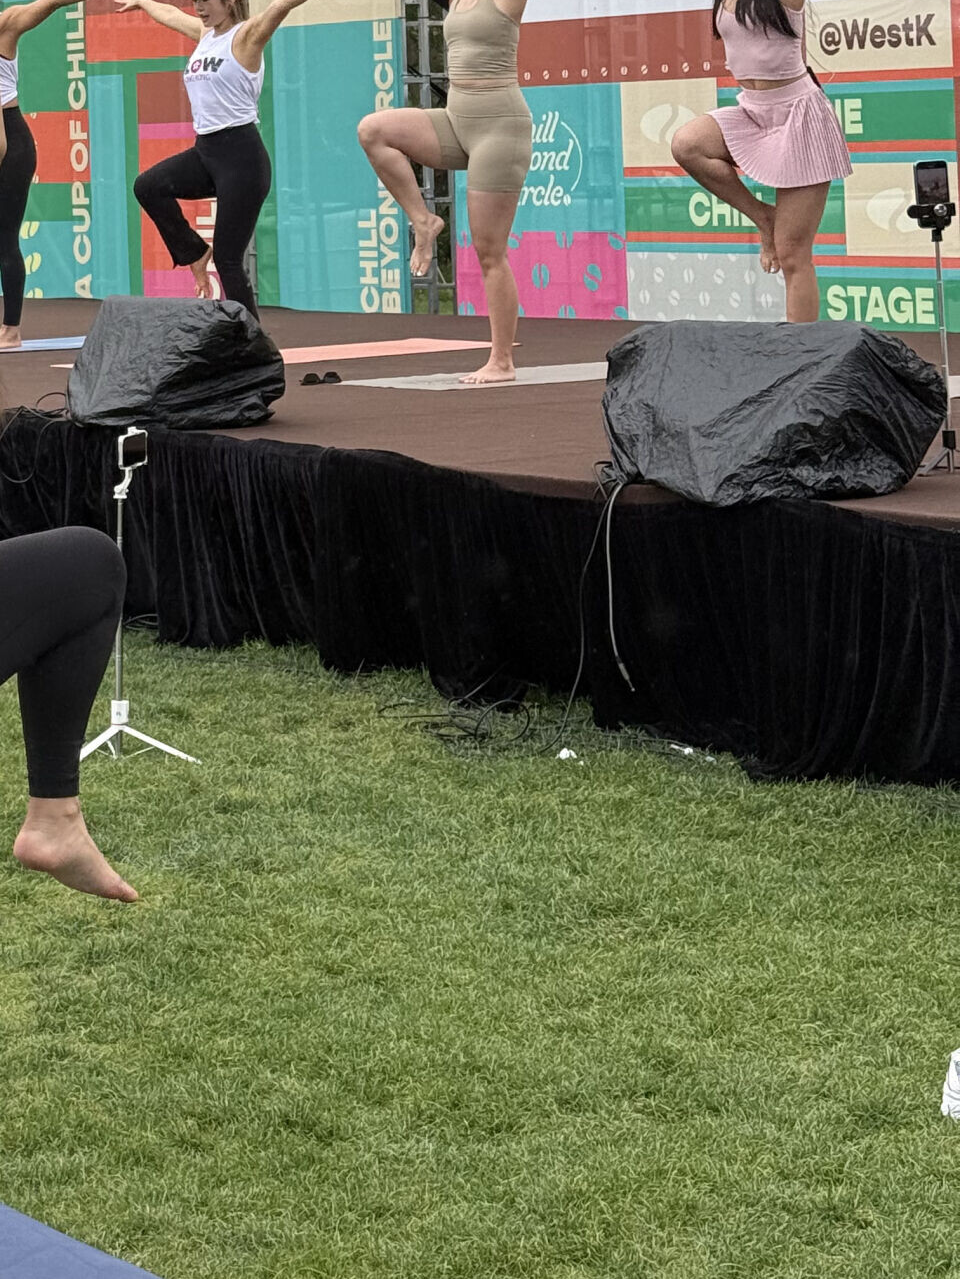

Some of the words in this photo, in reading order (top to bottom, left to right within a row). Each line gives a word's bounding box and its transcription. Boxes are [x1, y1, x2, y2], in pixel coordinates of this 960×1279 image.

[65, 0, 87, 112] CHILL
[818, 13, 937, 56] @WestK
[69, 119, 89, 173] OF
[71, 180, 92, 265] CUP
[377, 177, 401, 314] BEYON
[74, 274, 92, 299] A
[358, 209, 381, 314] CHILL
[826, 285, 936, 325] STAGE
